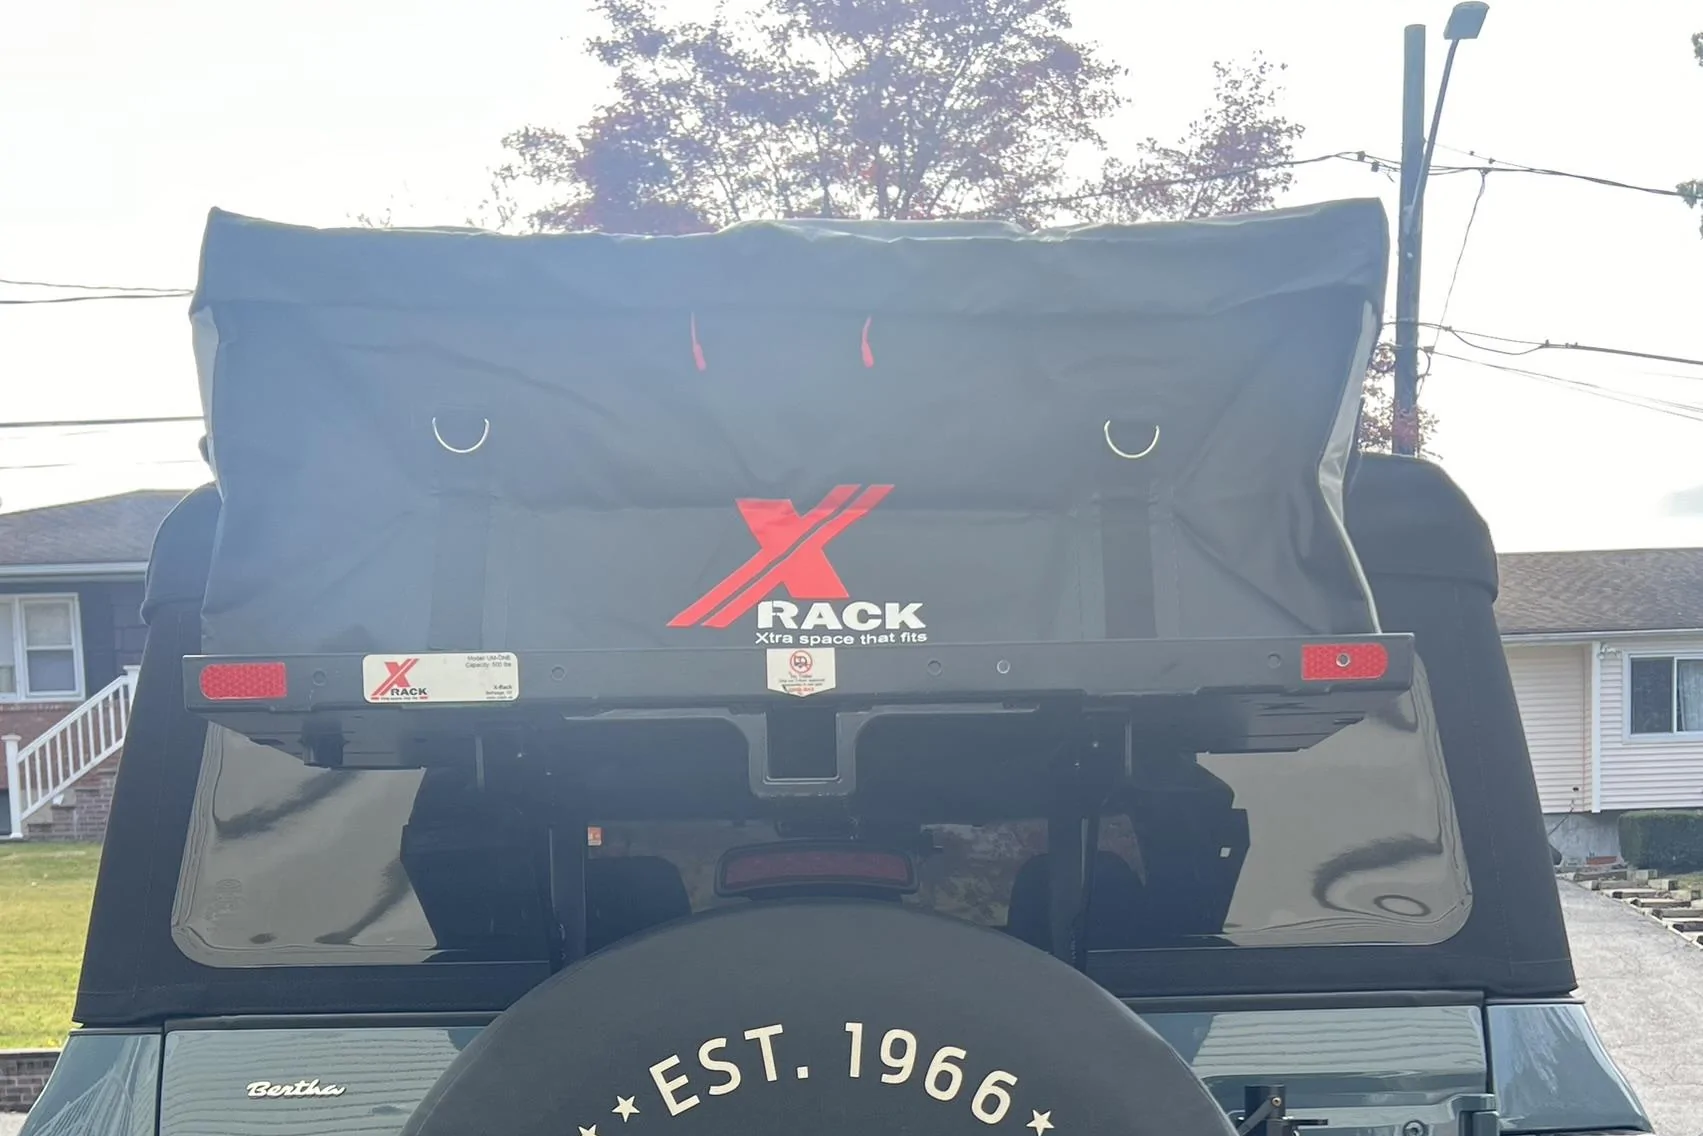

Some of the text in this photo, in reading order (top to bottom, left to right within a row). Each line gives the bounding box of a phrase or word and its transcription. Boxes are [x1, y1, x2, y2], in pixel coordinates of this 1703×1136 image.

[756, 600, 927, 631] RACK
[755, 631, 928, 647] Xtra space that fits
[390, 687, 428, 696] RACK
[648, 1021, 1018, 1125] EST. 1966
[246, 1078, 346, 1097] Bertha
